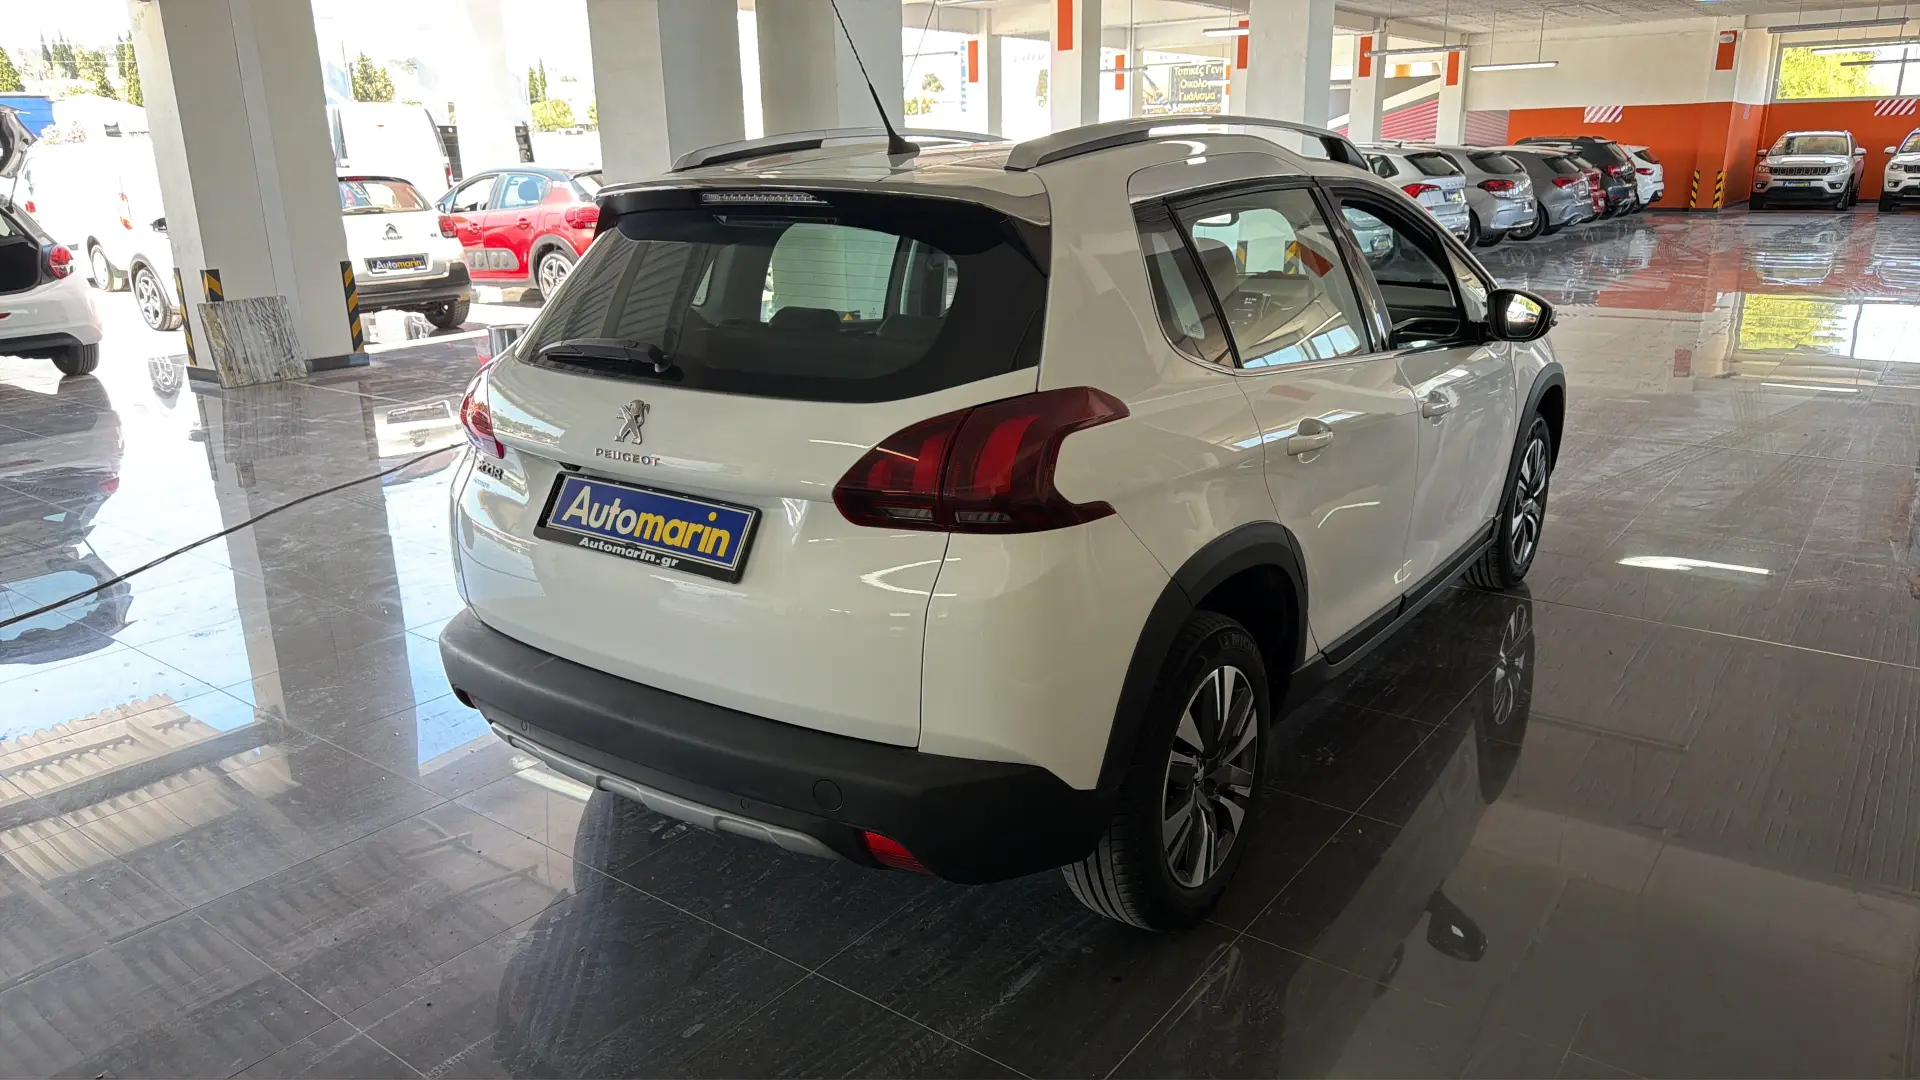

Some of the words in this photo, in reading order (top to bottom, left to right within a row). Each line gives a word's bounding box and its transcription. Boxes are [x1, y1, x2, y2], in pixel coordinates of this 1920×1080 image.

[376, 257, 421, 270] Automarin
[595, 447, 660, 466] PEUGEOT
[561, 485, 731, 557] Automarin
[579, 537, 679, 567] Automarin.gr
